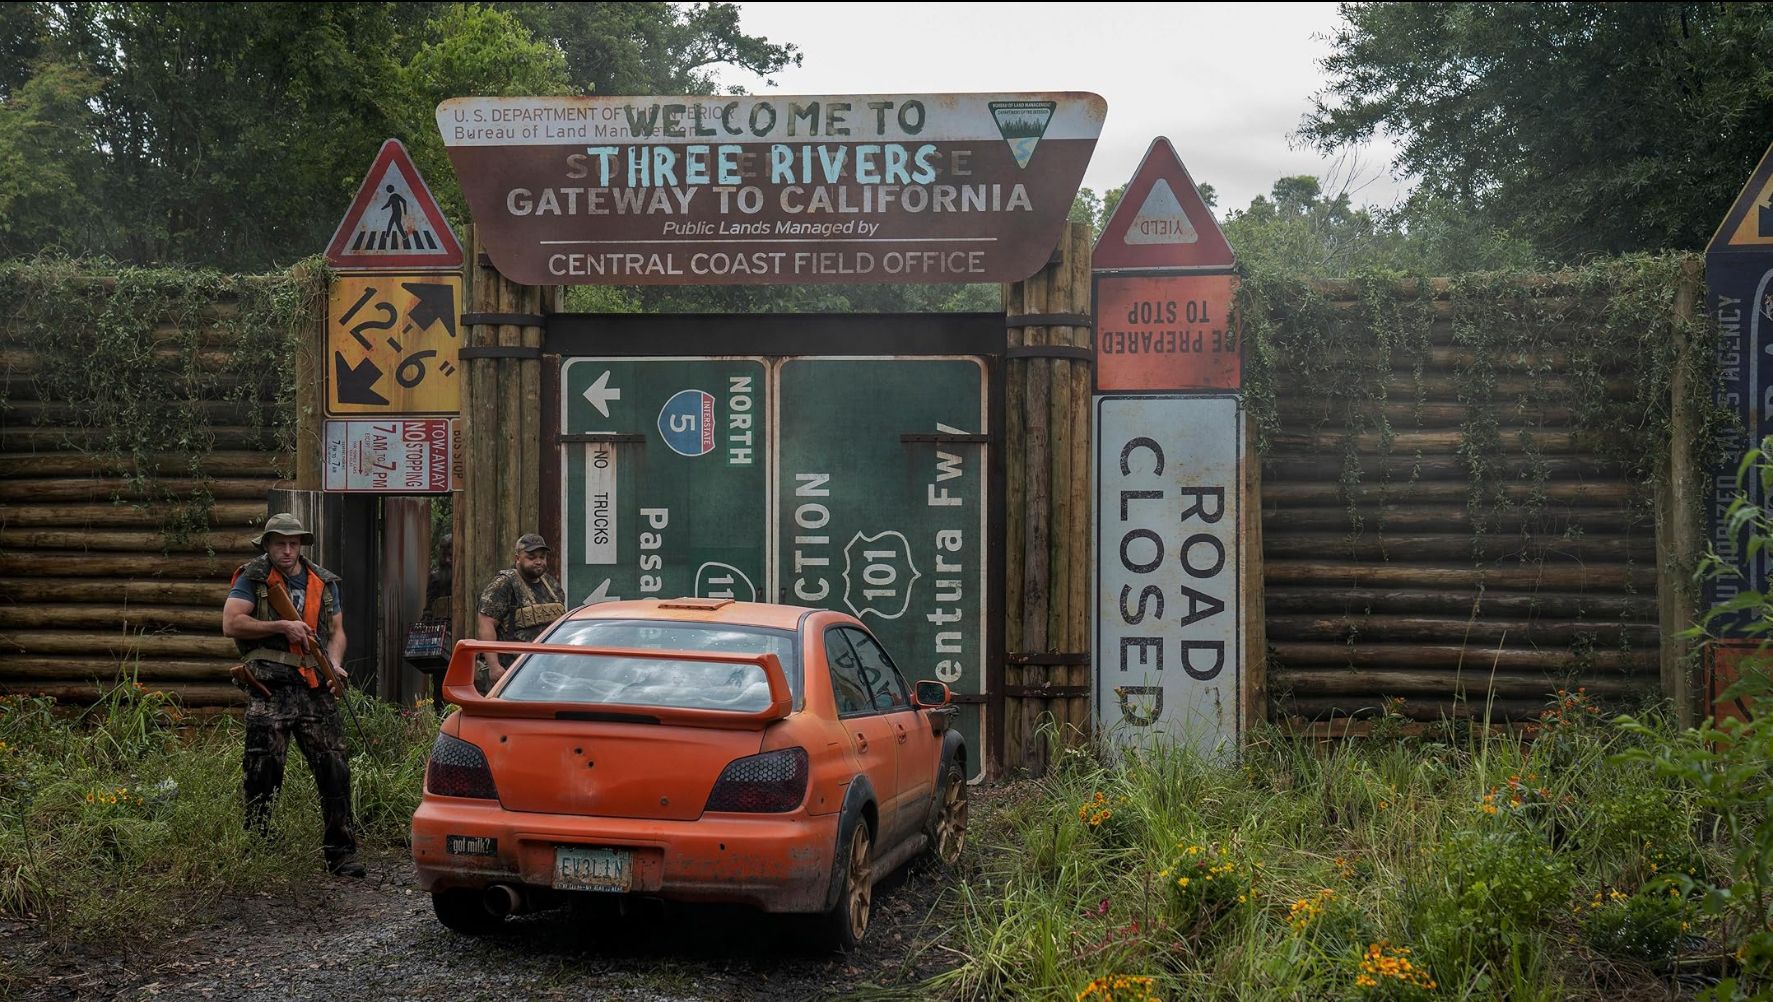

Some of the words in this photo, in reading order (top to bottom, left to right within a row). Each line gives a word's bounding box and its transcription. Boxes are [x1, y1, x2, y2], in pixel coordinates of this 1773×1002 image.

[492, 107, 598, 122] DEPARTMENT
[602, 107, 622, 121] OF
[624, 101, 851, 137] WELCOME
[867, 99, 926, 135] TO
[454, 126, 515, 140] Bureau
[522, 125, 538, 138] of
[546, 124, 587, 138] Land
[586, 145, 743, 187] THREE
[771, 143, 938, 186] RIVERS
[506, 186, 698, 216] GATEWAY
[713, 186, 764, 215] TO
[779, 184, 1033, 214] CALIFORNIA
[663, 221, 716, 235] Public
[719, 220, 771, 235] Lands
[775, 220, 854, 237] Managed
[857, 220, 880, 237] by
[1140, 220, 1183, 235] YIELD
[549, 252, 683, 276] CENTRAL
[690, 252, 786, 275] COAST
[794, 251, 875, 274] FIELD
[882, 251, 985, 274] OFFICE
[1127, 301, 1177, 325] STOP
[1186, 300, 1210, 324] TO
[1102, 330, 1203, 354] PREPARED
[1717, 294, 1742, 381] AGENCY
[373, 424, 396, 434] 7
[404, 422, 426, 441] NO
[669, 413, 696, 433] 5
[703, 400, 712, 446] INTERSTATE
[729, 376, 752, 464] NORTH
[373, 435, 388, 451] AM
[431, 422, 446, 488] TOW-AWAY
[373, 461, 396, 471] 7
[406, 443, 423, 487] STOPPING
[593, 450, 609, 469] NO
[373, 473, 388, 488] PM
[593, 492, 609, 545] TRUCKS
[640, 507, 669, 600] Pasa
[794, 473, 831, 609] CTION
[1712, 475, 1738, 613] UTHORIZED
[863, 549, 897, 597] 101
[1119, 436, 1165, 728] CLOSED
[1180, 486, 1225, 681] ROAD
[927, 529, 963, 694] entura
[453, 837, 466, 855] got
[467, 837, 491, 854] milk?
